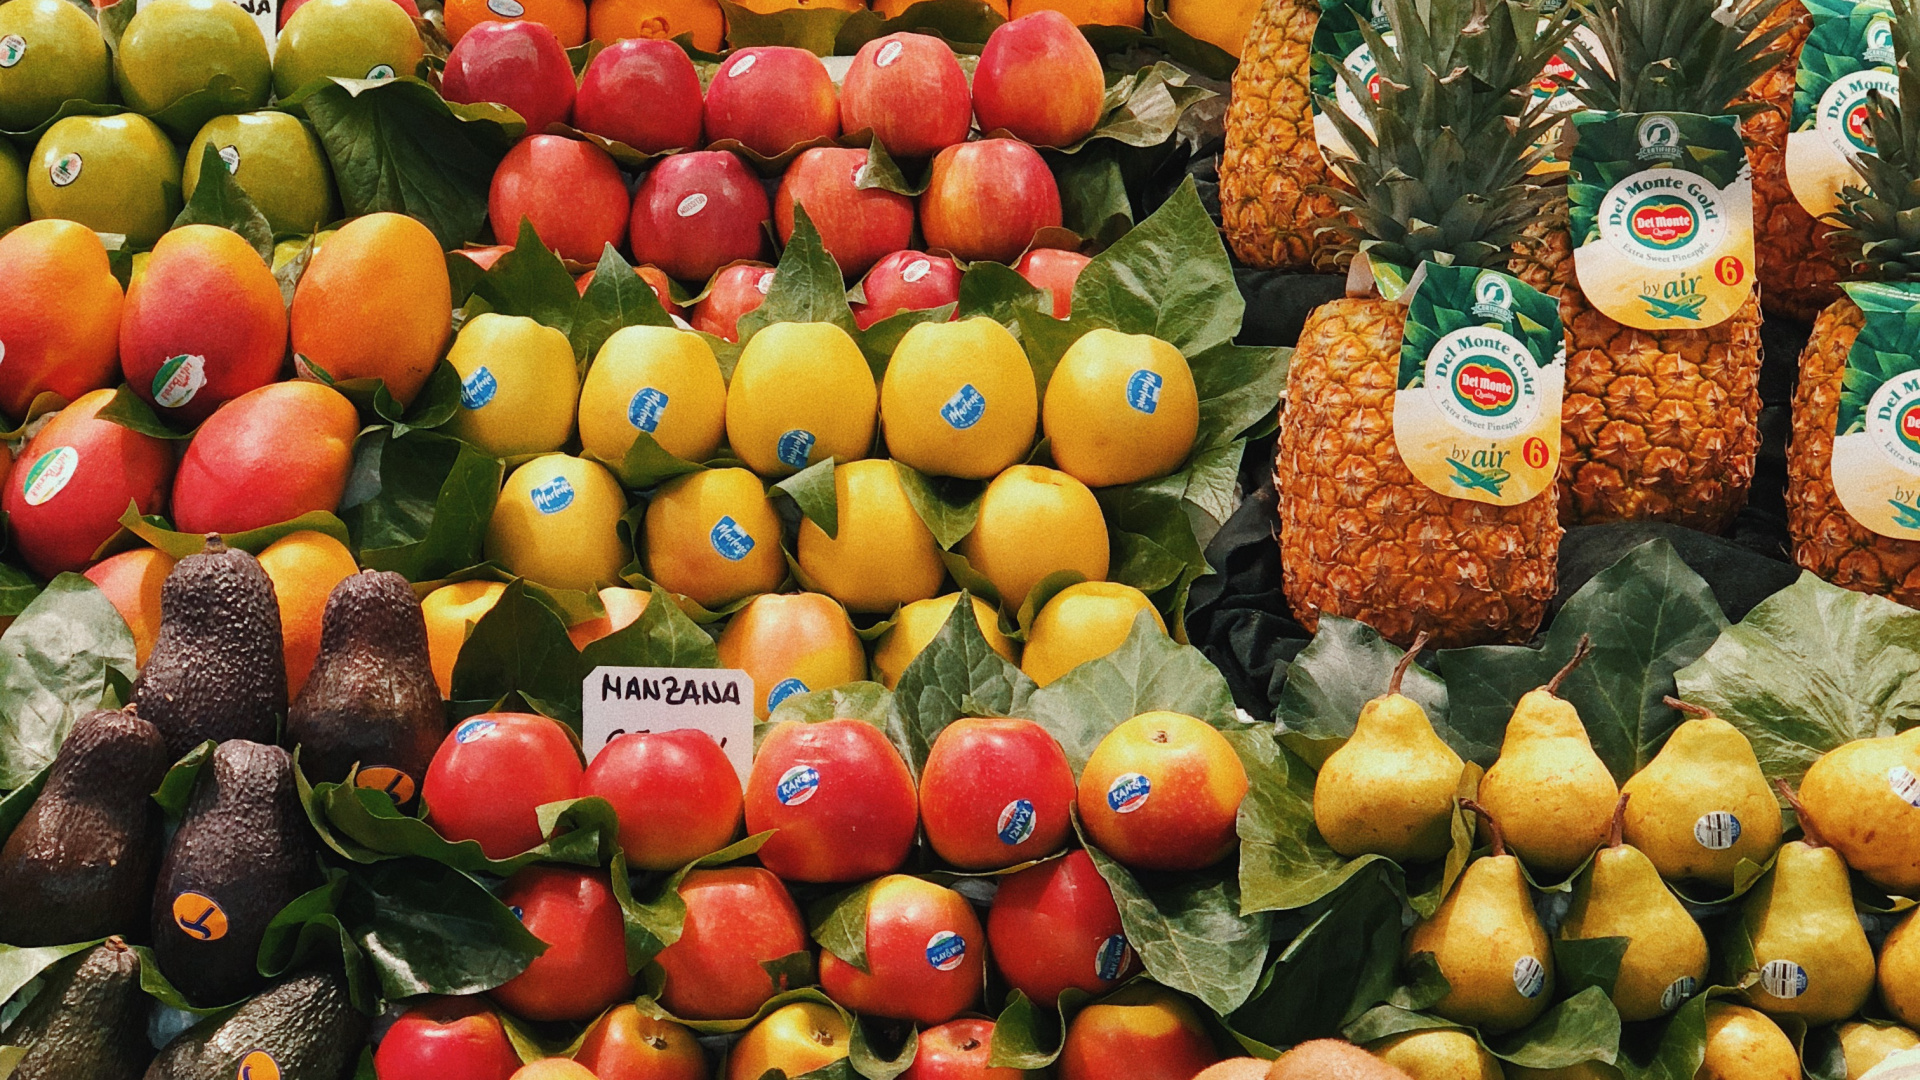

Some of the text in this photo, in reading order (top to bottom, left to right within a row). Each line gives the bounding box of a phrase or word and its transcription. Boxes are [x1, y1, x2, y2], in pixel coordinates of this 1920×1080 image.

[1827, 80, 1899, 120] Del Monte
[1852, 114, 1865, 126] De
[1609, 176, 1718, 226] Del Monte Gold
[1637, 215, 1690, 229] Del Monte
[1653, 227, 1676, 237] Quality
[1622, 242, 1709, 263] Extra Sweet Pineapple
[1721, 257, 1738, 286] 6
[1643, 272, 1703, 299] by air
[1435, 336, 1535, 396] Del Monte Gold
[461, 375, 492, 402] Marlene
[1135, 372, 1156, 408] Marlene
[1462, 374, 1512, 395] Del Monte
[1475, 389, 1497, 402] Quality
[636, 390, 661, 427] Marlene
[949, 392, 980, 423] Marlene
[1441, 398, 1523, 431] Extra Sweet Pineapple
[1877, 389, 1902, 421] Del
[787, 430, 809, 464] Marlene
[1452, 442, 1511, 468] by air
[1529, 439, 1543, 467] 6
[1884, 441, 1905, 461] Extra
[535, 484, 571, 508] Marlene
[1895, 486, 1914, 503] by
[716, 523, 747, 555] Marlene
[602, 674, 742, 706] MANZANA
[1112, 777, 1141, 802] KANZI
[1008, 807, 1031, 840] KANZI
[931, 951, 946, 964] PLAY
[1106, 962, 1118, 979] PLAY
